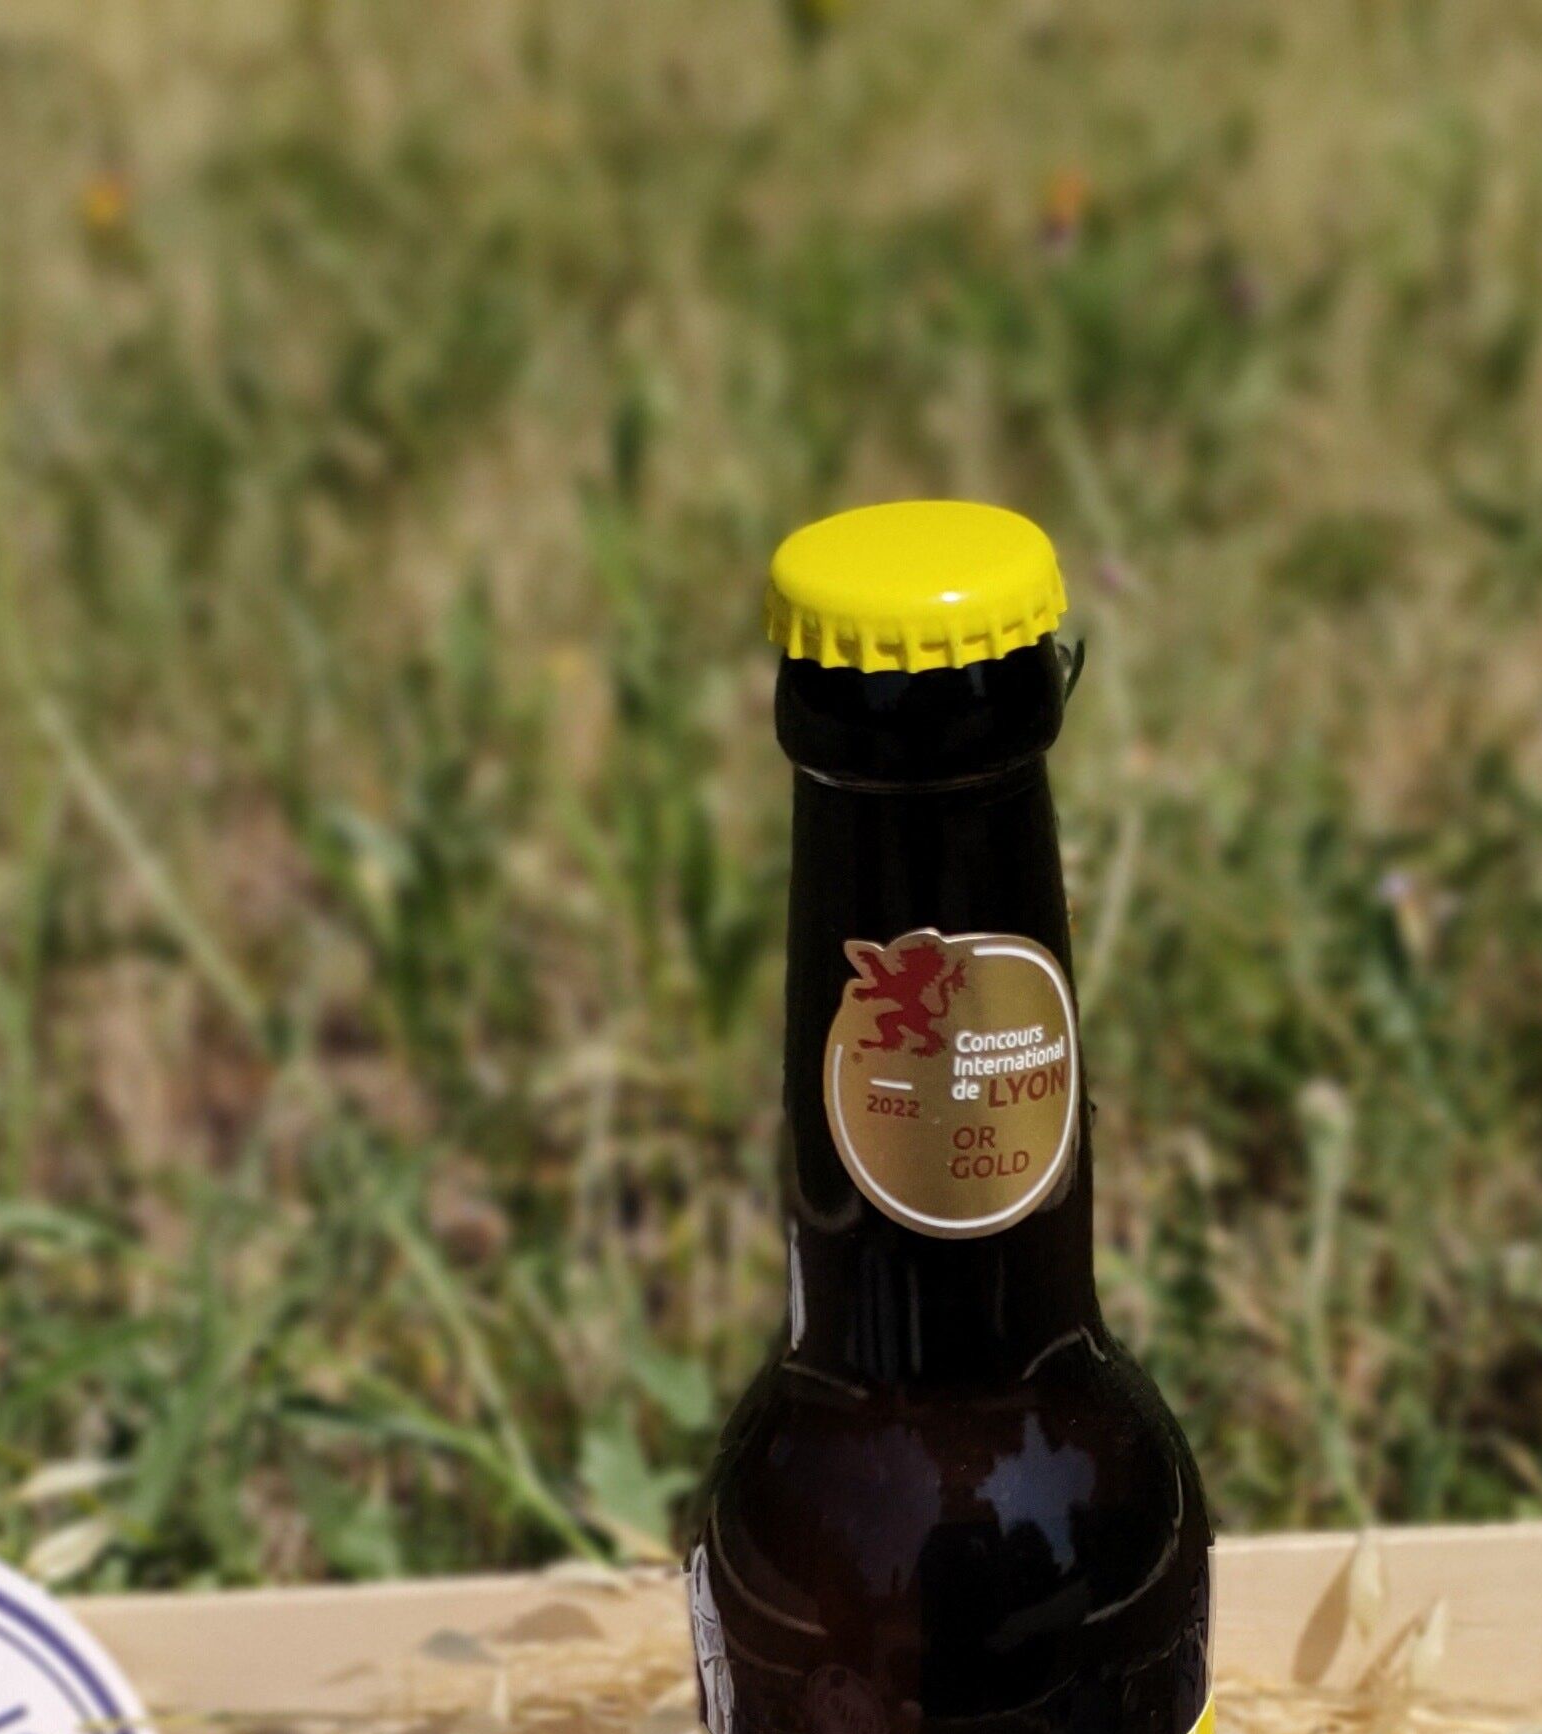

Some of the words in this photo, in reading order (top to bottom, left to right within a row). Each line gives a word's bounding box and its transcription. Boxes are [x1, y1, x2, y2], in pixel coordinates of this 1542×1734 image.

[956, 1026, 1044, 1053] Concours
[953, 1036, 1066, 1077] International
[951, 1079, 980, 1101] de
[988, 1065, 1067, 1108] LYON
[866, 1094, 921, 1120] 2022
[952, 1126, 996, 1150] OR
[950, 1151, 1031, 1180] GOLD
